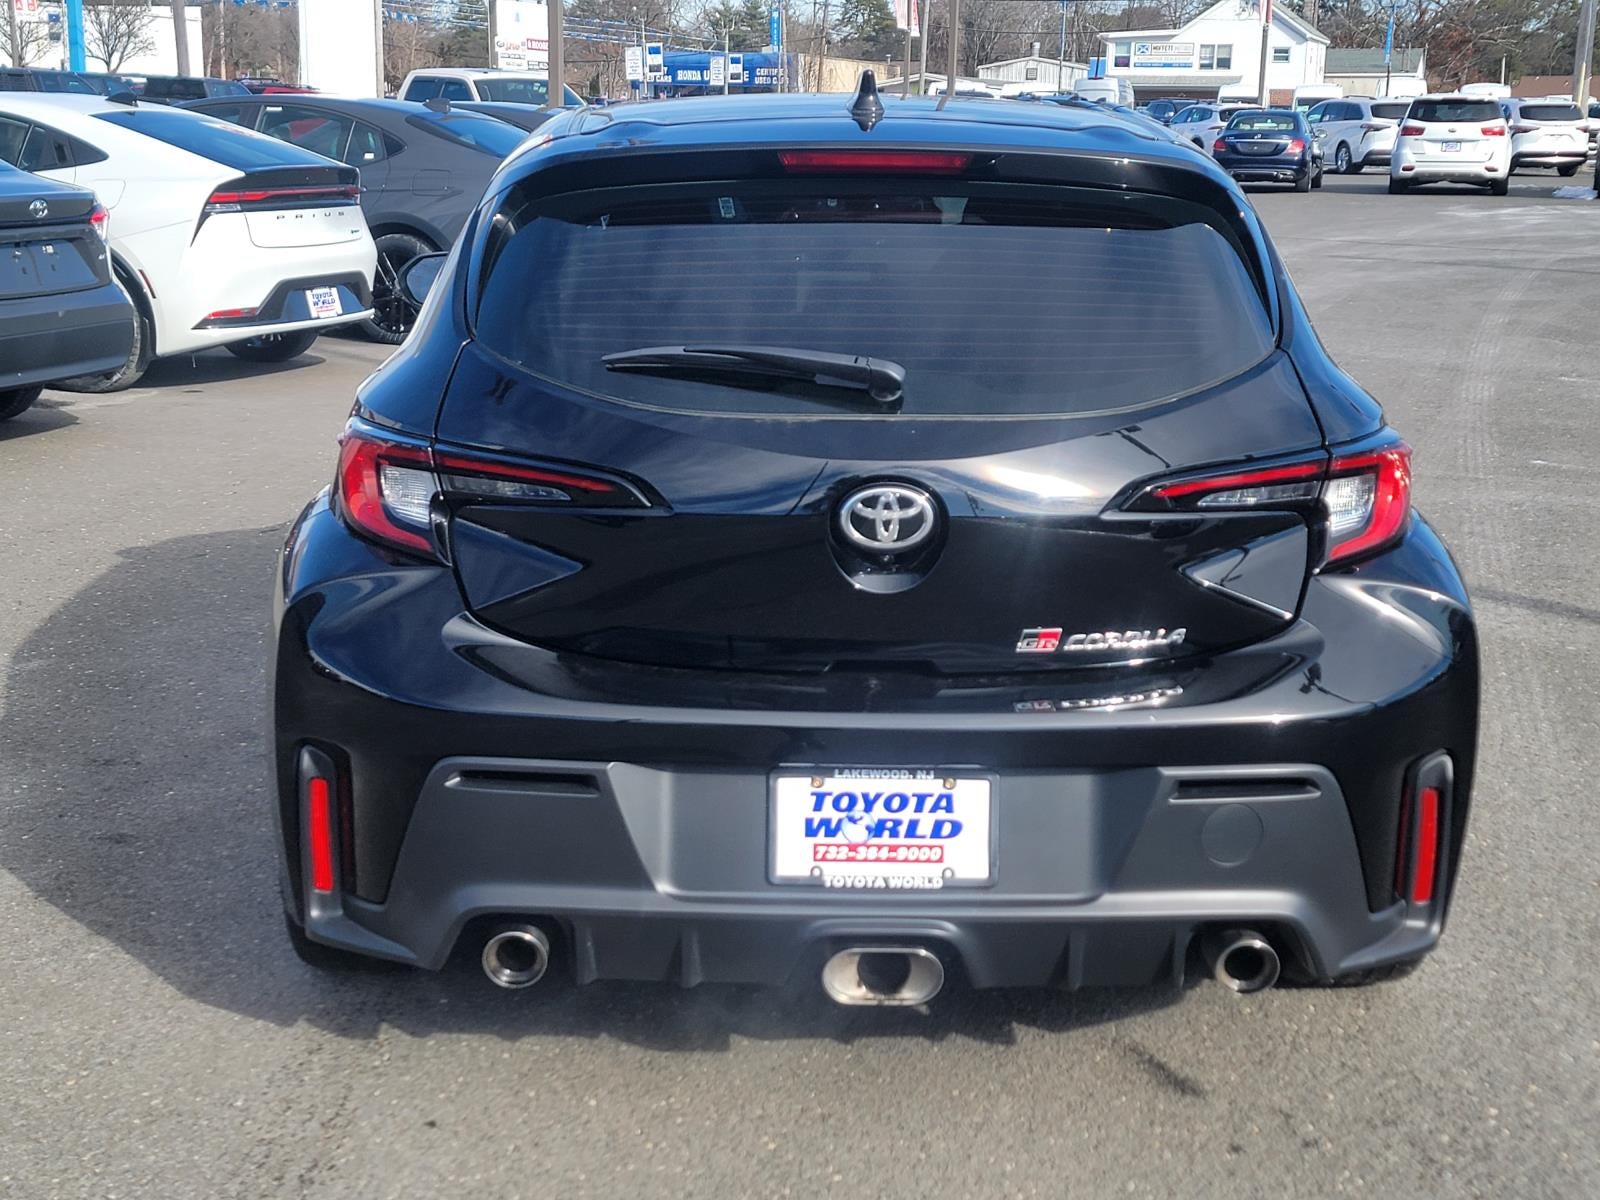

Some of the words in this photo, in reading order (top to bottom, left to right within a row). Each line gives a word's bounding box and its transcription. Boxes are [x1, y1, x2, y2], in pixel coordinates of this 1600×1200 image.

[677, 70, 701, 81] HONDA
[755, 76, 771, 84] USED
[276, 211, 345, 220] PRIUS
[312, 292, 333, 300] TOYOTA
[1018, 636, 1059, 651] GR
[1063, 628, 1187, 651] COROLLA
[916, 770, 935, 780] NJ
[810, 791, 954, 814] TOYOTA
[805, 814, 963, 842] WORLD
[815, 845, 942, 860] 732-364-9000
[823, 875, 886, 888] TOYOTA
[888, 875, 944, 889] WORLD
